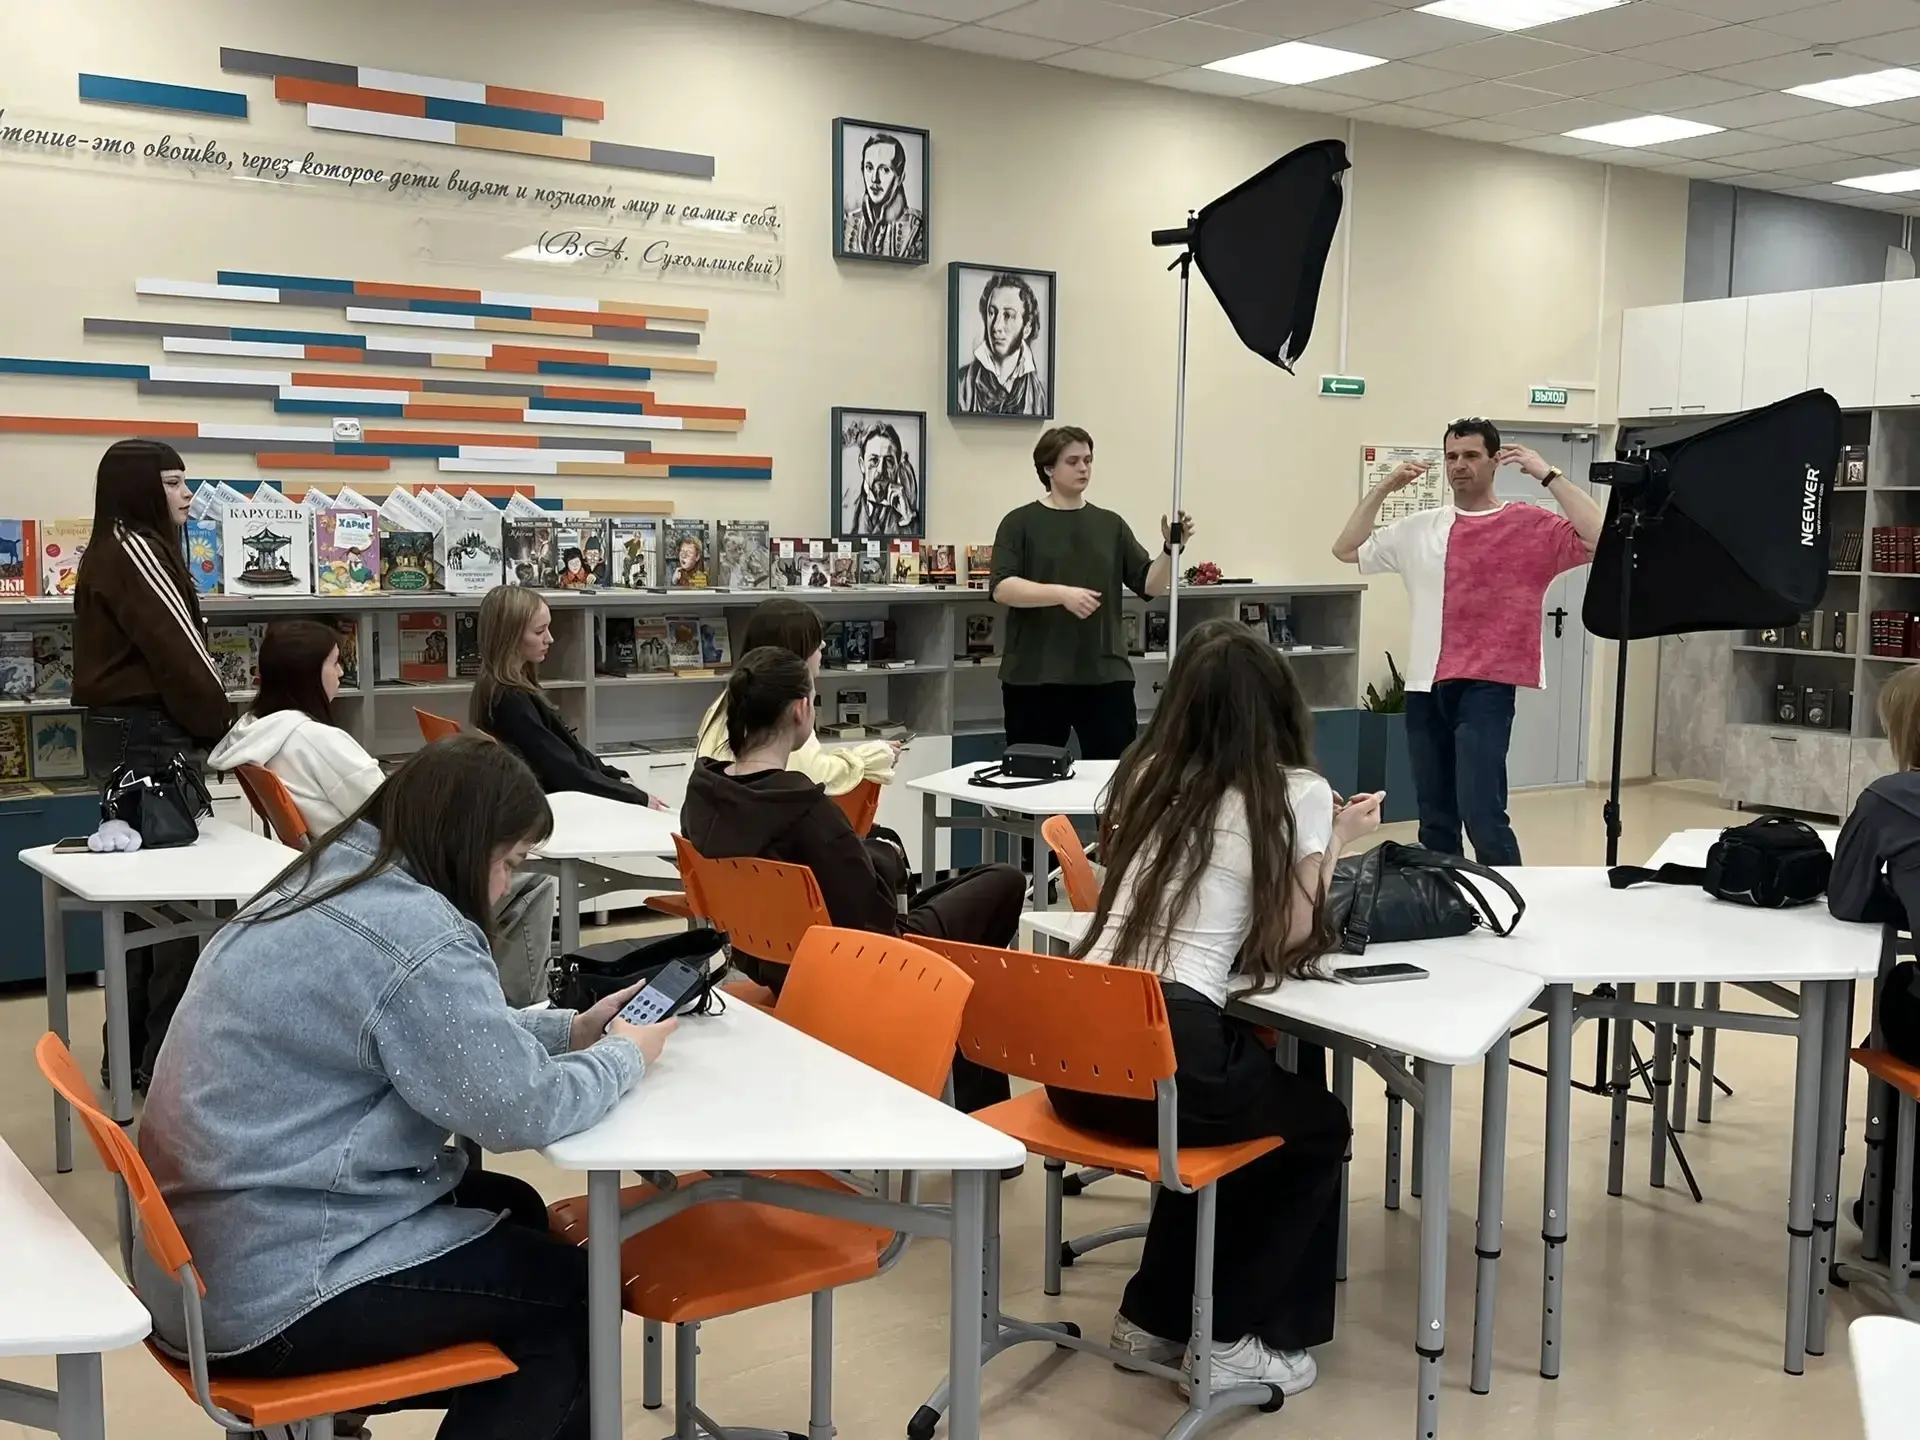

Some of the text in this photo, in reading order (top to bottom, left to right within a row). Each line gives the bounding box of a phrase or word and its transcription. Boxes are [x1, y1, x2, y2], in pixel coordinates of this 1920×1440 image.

[0, 108, 781, 228] тение-это окошко, через которое дети видят и познают мир и самих себя.
[643, 240, 783, 276] Сухомлинский)
[1535, 390, 1565, 404] ВЫХОД
[230, 508, 303, 520] КАРУСЕЛЬ
[1801, 468, 1820, 546] NEEWER
[338, 518, 370, 530] ХАРМС
